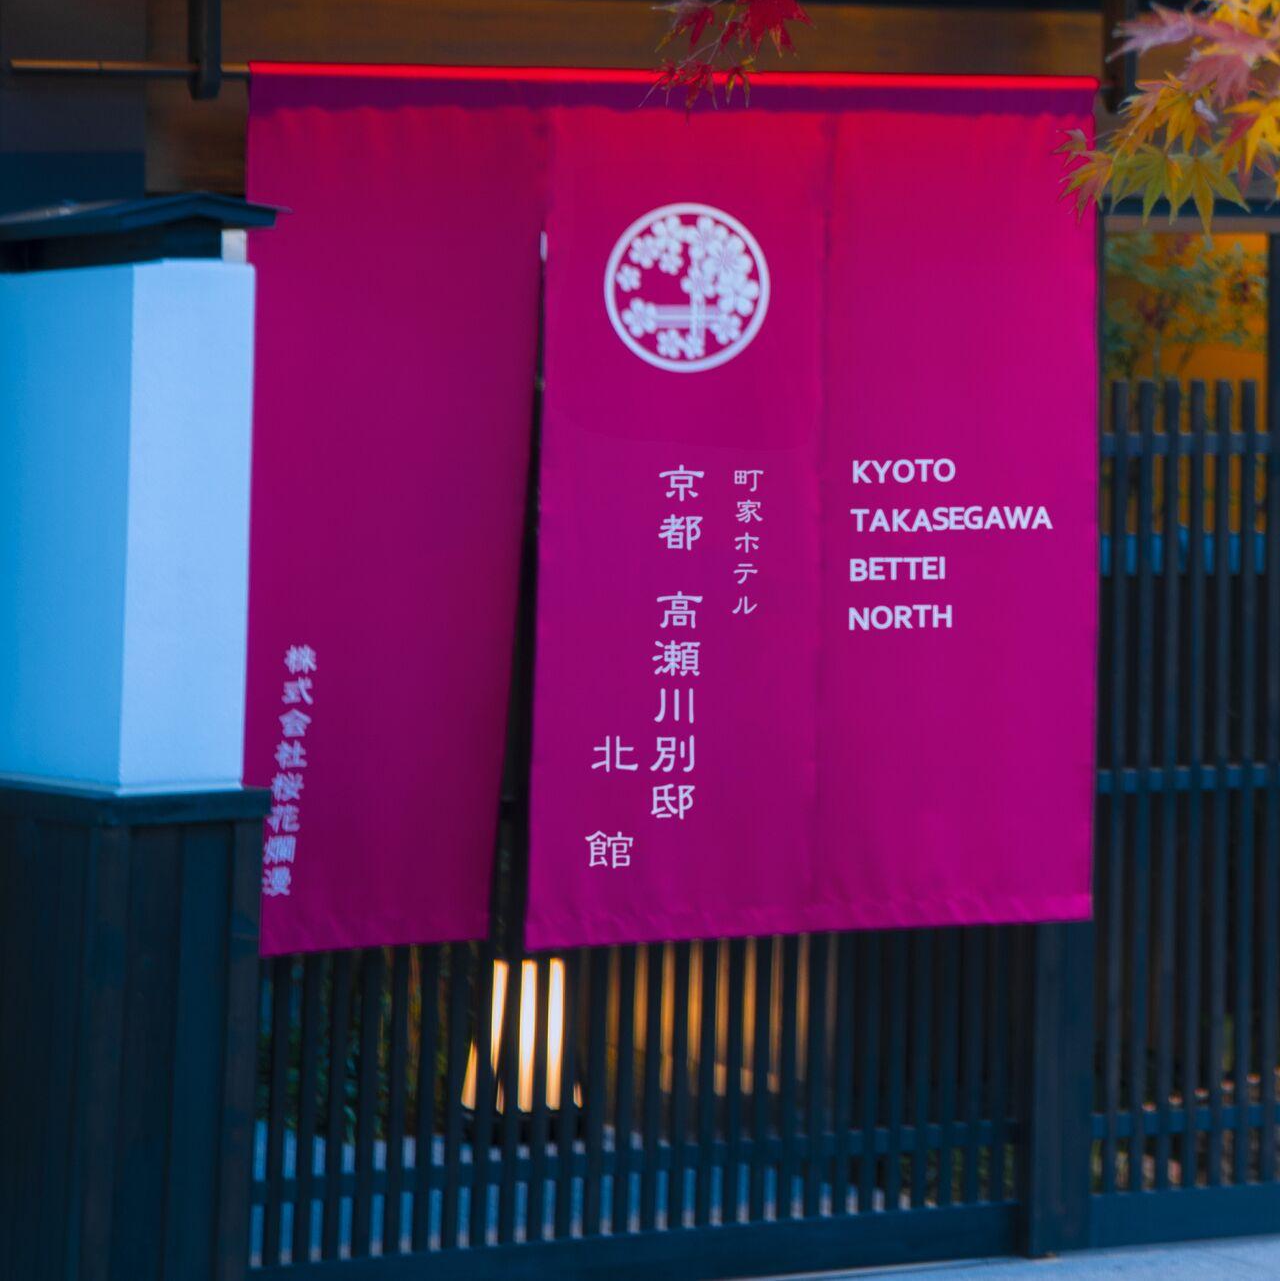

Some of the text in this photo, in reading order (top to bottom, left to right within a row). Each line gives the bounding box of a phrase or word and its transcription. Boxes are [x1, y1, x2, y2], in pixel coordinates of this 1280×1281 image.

[852, 458, 956, 484] KYOTO
[731, 469, 765, 615] 町家ホテル
[850, 505, 1054, 533] TAKASEGAWA
[849, 556, 946, 582] BETTEI
[650, 464, 705, 820] 京都 高瀬川別邸
[848, 604, 953, 631] NORTH
[262, 644, 317, 896] 株式会社桜花爛漫
[584, 735, 639, 869] 北館
